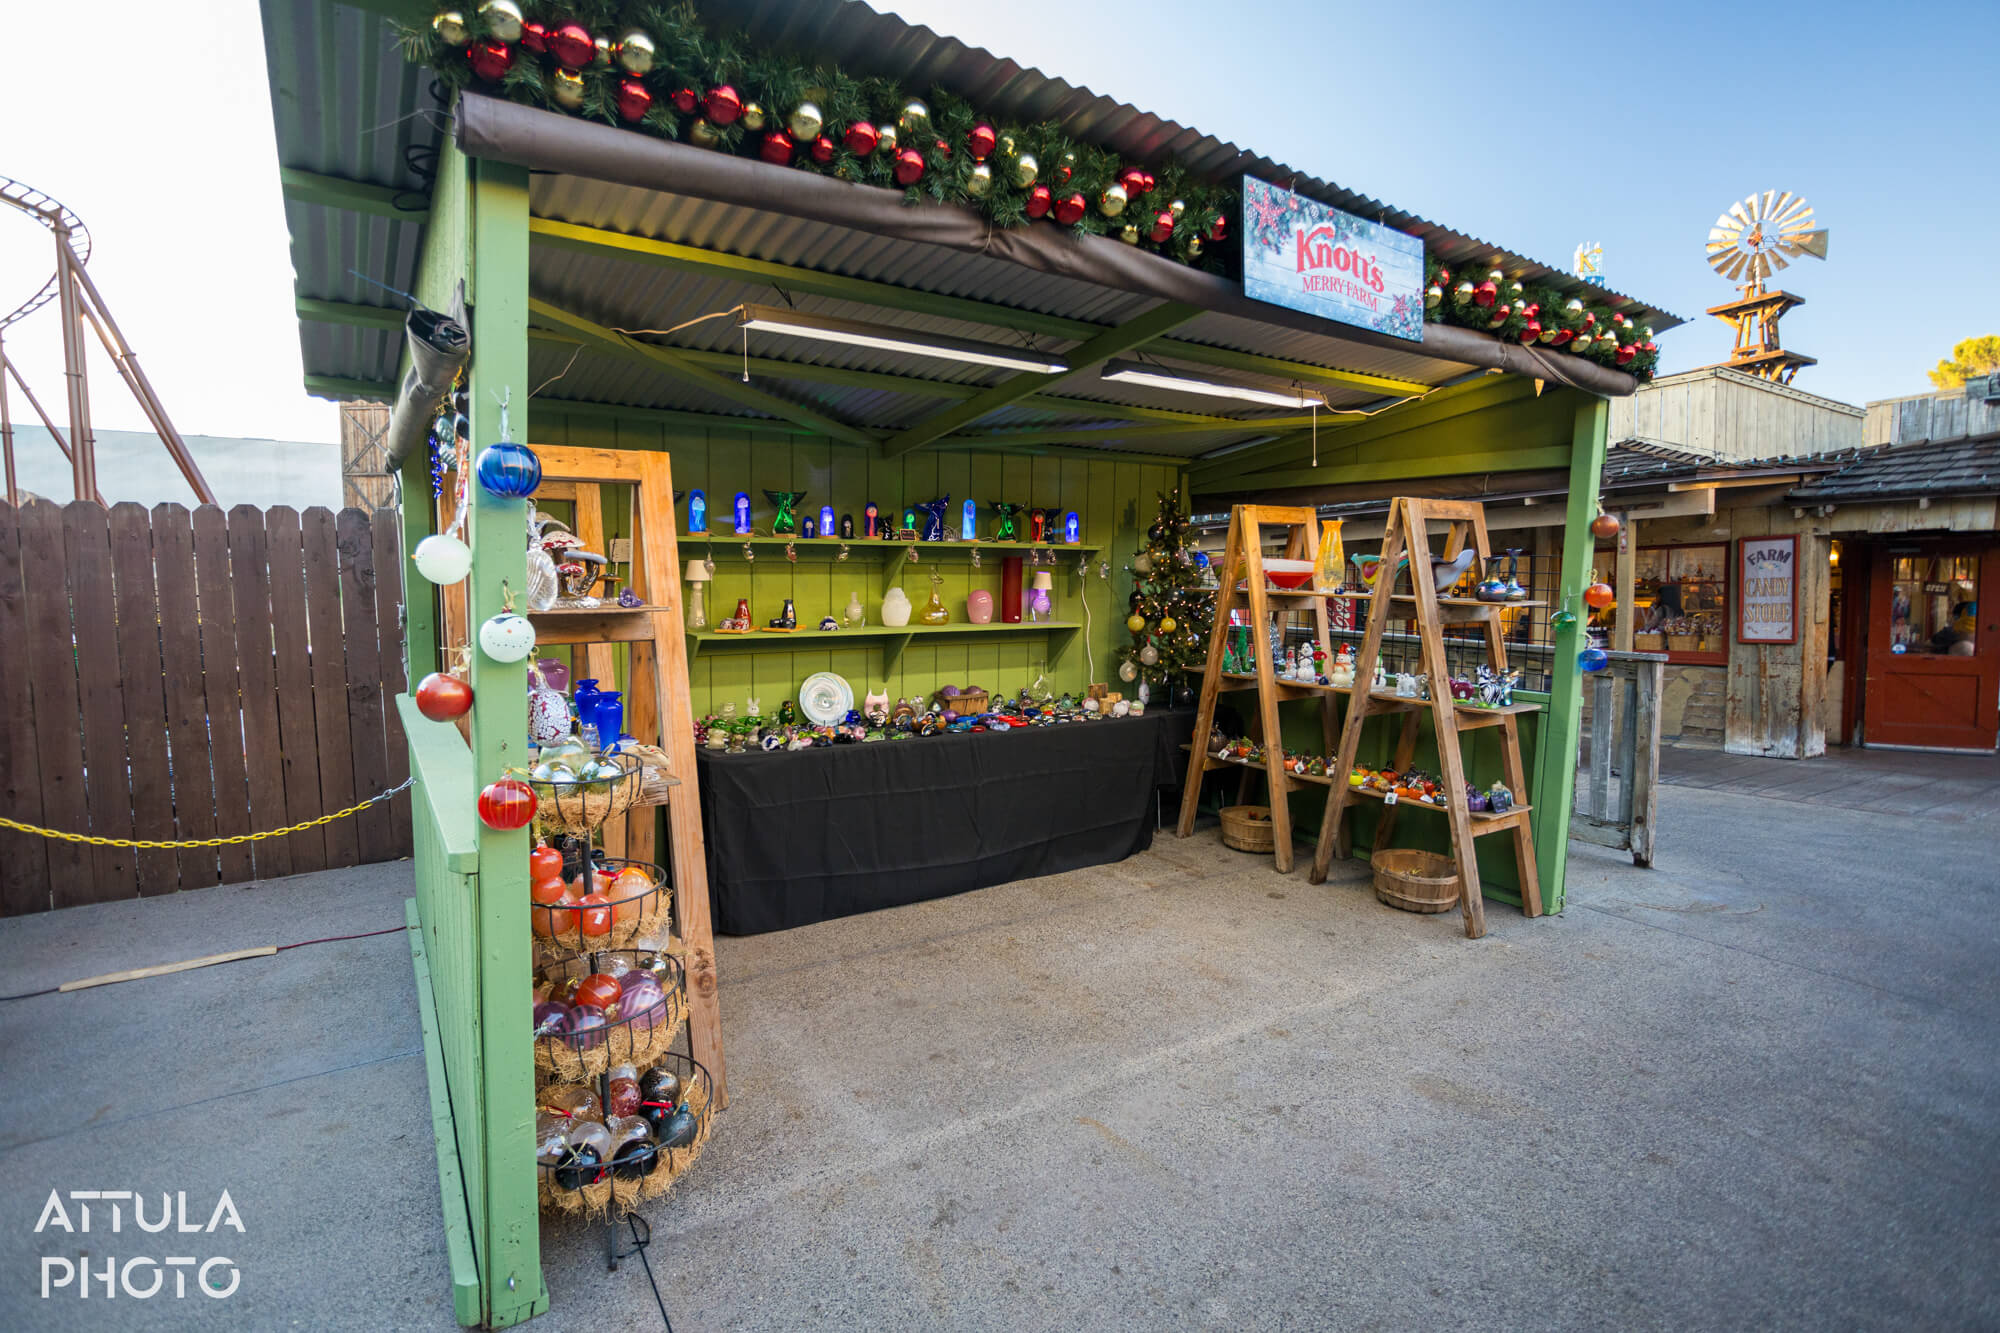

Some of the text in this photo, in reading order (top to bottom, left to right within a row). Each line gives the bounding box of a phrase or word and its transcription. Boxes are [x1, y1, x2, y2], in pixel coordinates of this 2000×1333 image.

[1296, 227, 1384, 293] Knott's
[1303, 275, 1377, 312] MERRY FARM
[1747, 549, 1792, 565] FARM
[1745, 577, 1790, 598] CANDY
[1744, 602, 1792, 623] STORE
